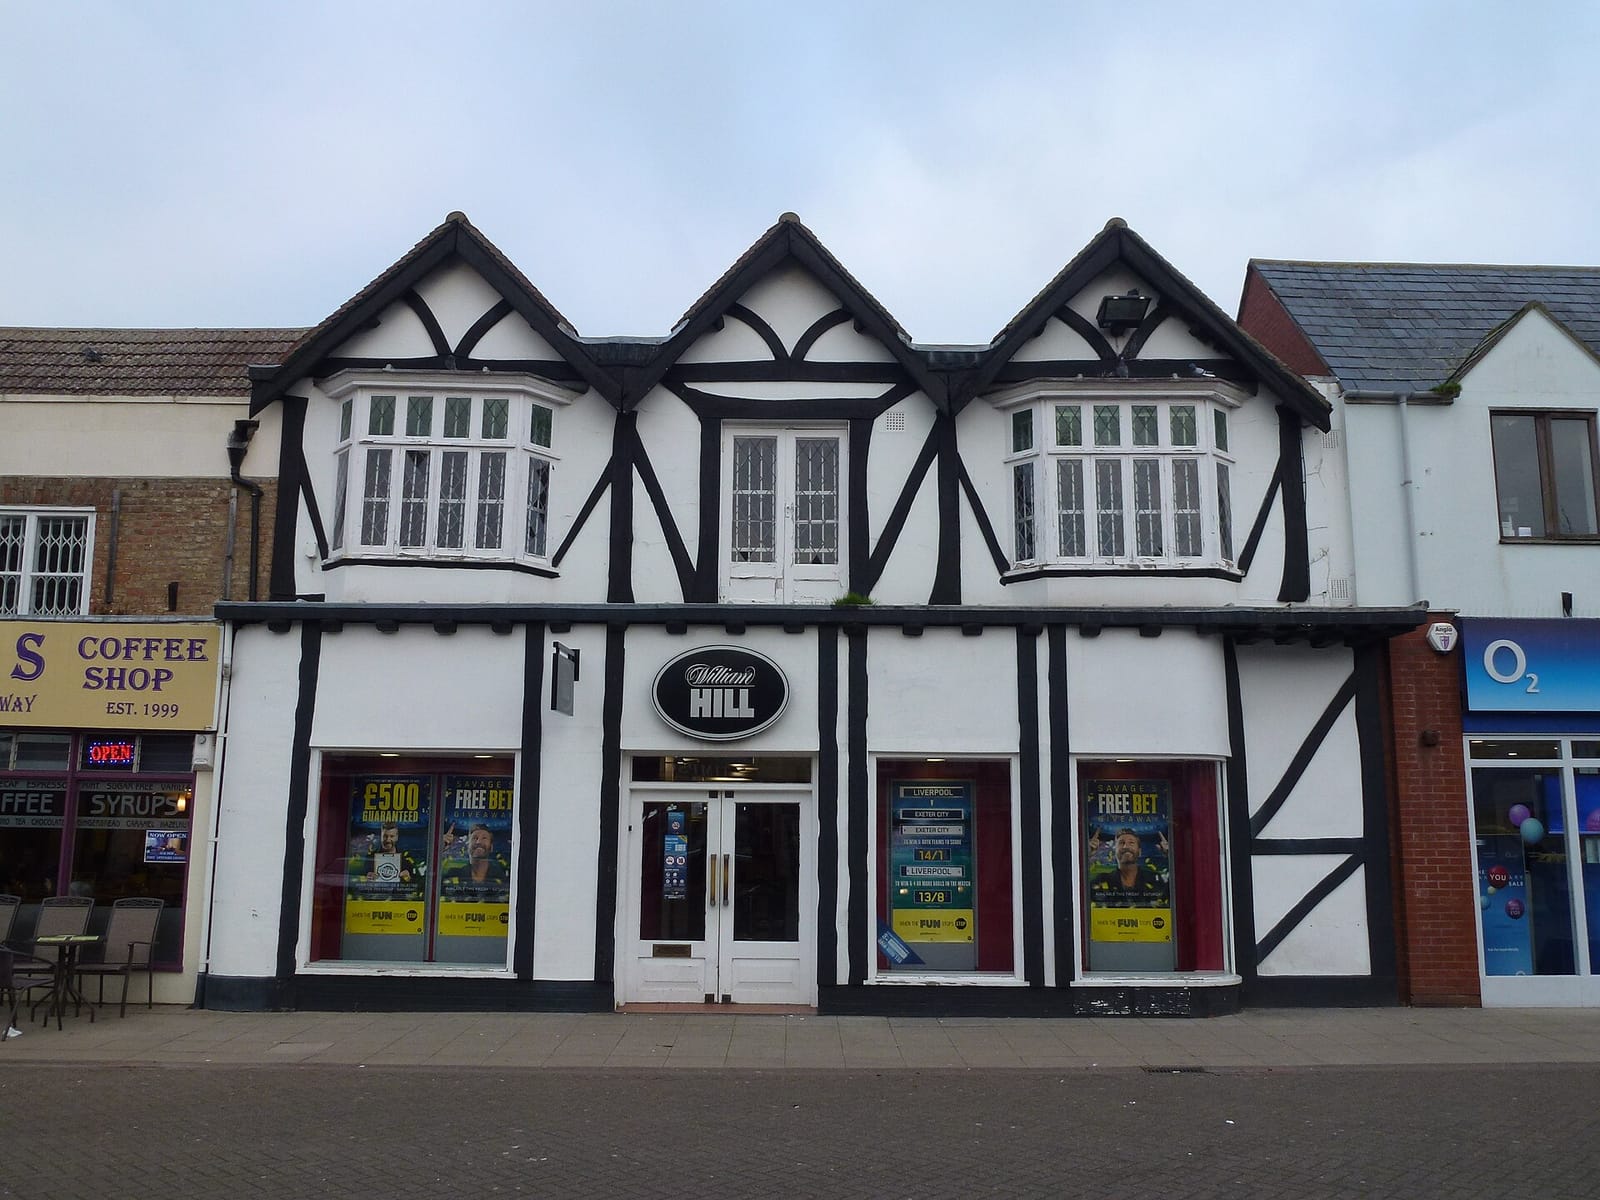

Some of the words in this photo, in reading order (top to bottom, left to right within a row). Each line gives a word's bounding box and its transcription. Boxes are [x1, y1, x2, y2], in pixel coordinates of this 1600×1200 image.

[10, 632, 46, 682] S
[78, 636, 209, 662] COFFEE
[1484, 639, 1540, 693] O2
[82, 666, 174, 692] SHOP
[685, 663, 756, 687] William
[106, 702, 137, 716] EST.
[143, 703, 179, 718] 1999
[690, 688, 755, 718] HILL
[91, 744, 131, 761] OPEN
[363, 783, 419, 811] £500
[455, 789, 487, 810] FREE
[488, 789, 513, 810] BET
[913, 788, 954, 796] LIVERPOOL
[90, 794, 178, 816] SYRUPS
[1098, 793, 1130, 814] FREE
[1132, 793, 1158, 814] BET
[362, 810, 419, 823] GUARANTEED
[919, 850, 944, 860] 14/1
[911, 867, 952, 875] LIVERPOOL
[919, 891, 945, 902] 13/8
[371, 911, 393, 920] FUN
[465, 913, 486, 922] FUN
[919, 919, 941, 928] FUN
[1117, 918, 1139, 928] FUN
